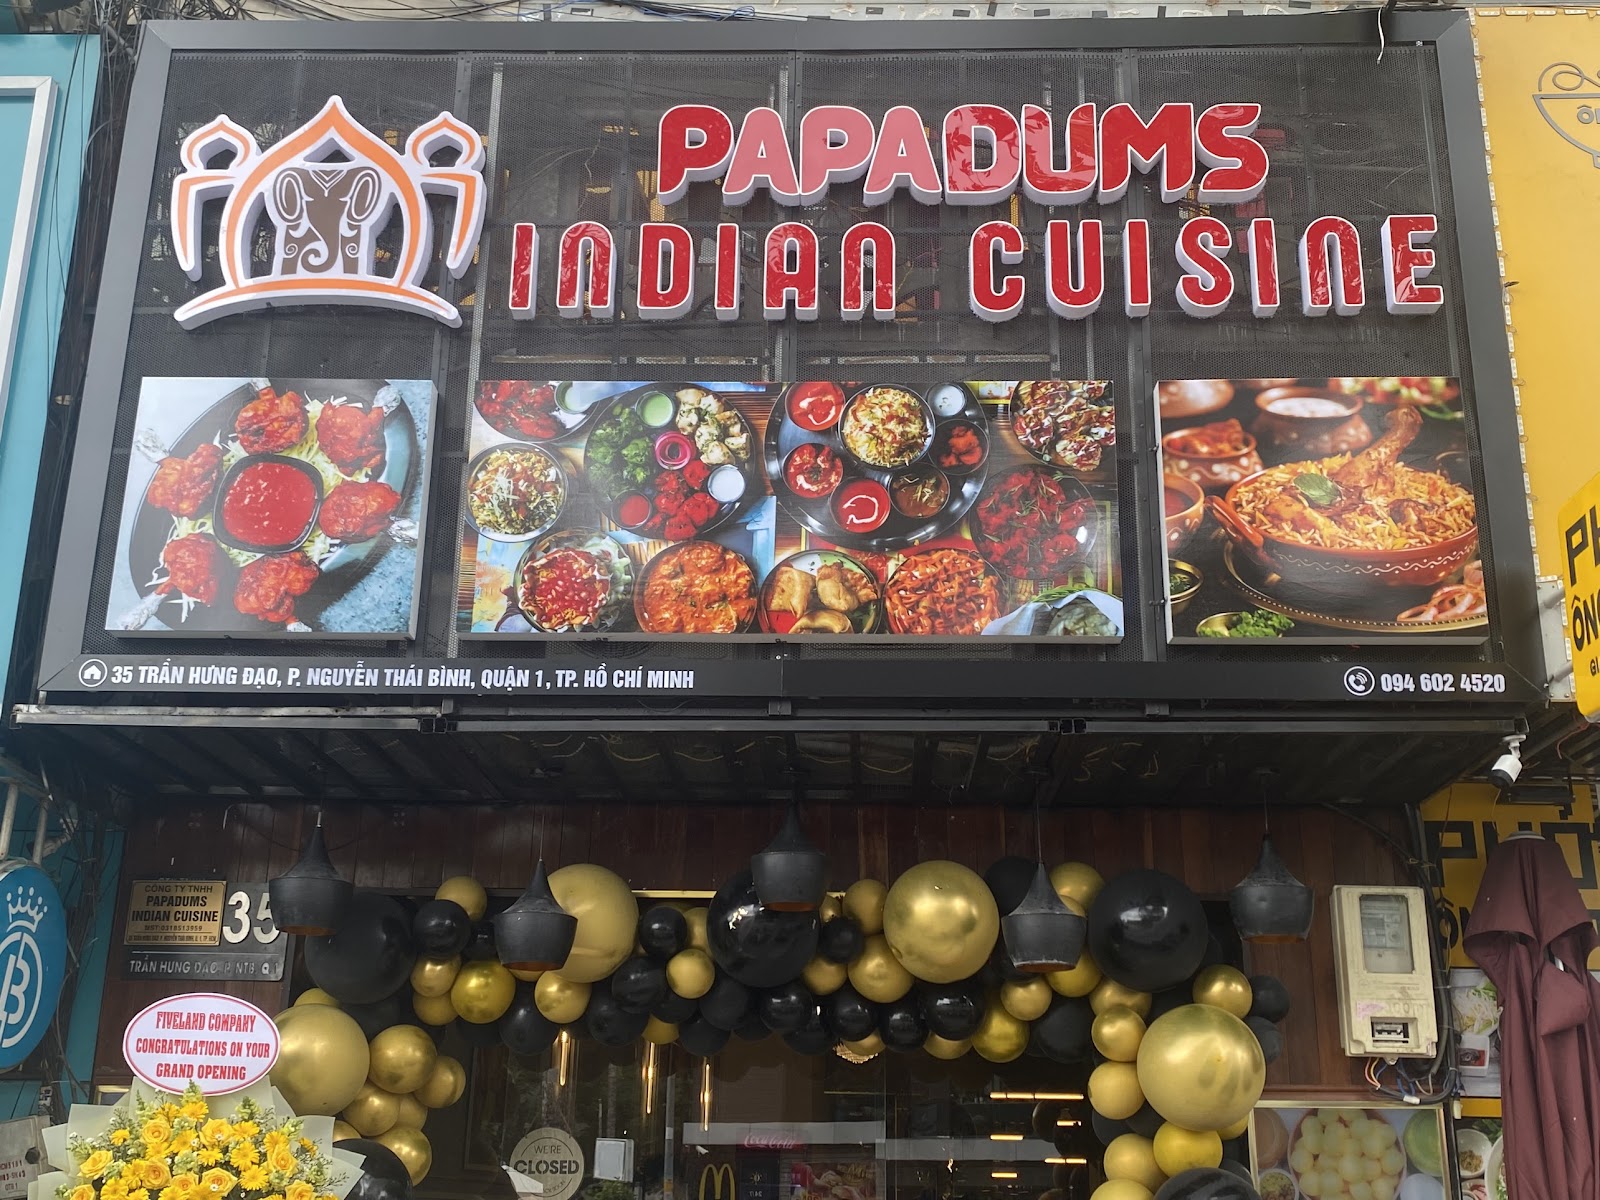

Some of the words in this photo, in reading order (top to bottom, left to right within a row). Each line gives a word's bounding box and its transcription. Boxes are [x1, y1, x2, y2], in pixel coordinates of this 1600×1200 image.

[658, 102, 1270, 206] PAPADUMS
[509, 221, 897, 321] INDIAN
[969, 214, 1445, 322] CUISINE
[111, 665, 133, 684] 35
[138, 658, 184, 684] TRẦN
[188, 665, 237, 685] HƯNG
[242, 667, 282, 690] ĐẠO,
[287, 667, 300, 687] P.
[306, 660, 378, 687] NGUYỄN
[384, 664, 423, 687] THÁI
[428, 665, 476, 690] BÌNH,
[481, 665, 530, 691] QUẬN
[535, 670, 551, 690] 1,
[555, 669, 579, 688] TP.
[584, 663, 608, 689] HỒ
[612, 666, 643, 689] CHÍ
[646, 670, 694, 689] MINH
[1380, 673, 1415, 692] 094
[1420, 673, 1456, 692] 602
[1460, 673, 1506, 693] 4520
[144, 884, 172, 893] CÔNG
[175, 885, 187, 893] TY
[188, 885, 213, 893] TNHH
[146, 895, 208, 907] PAPADUMS
[131, 910, 170, 922] INDIAN
[173, 910, 219, 922] CUISINE
[222, 891, 280, 944] 35
[156, 1011, 206, 1031] FIVELAND
[208, 1013, 257, 1033] COMPANY
[136, 1037, 228, 1057] CONGRATULATIONS
[230, 1041, 242, 1057] ON
[245, 1042, 270, 1058] YOUR
[156, 1063, 194, 1078] GRAND
[197, 1065, 246, 1081] OPENING
[534, 1145, 562, 1154] WE'RE
[513, 1159, 580, 1175] CLOSED
